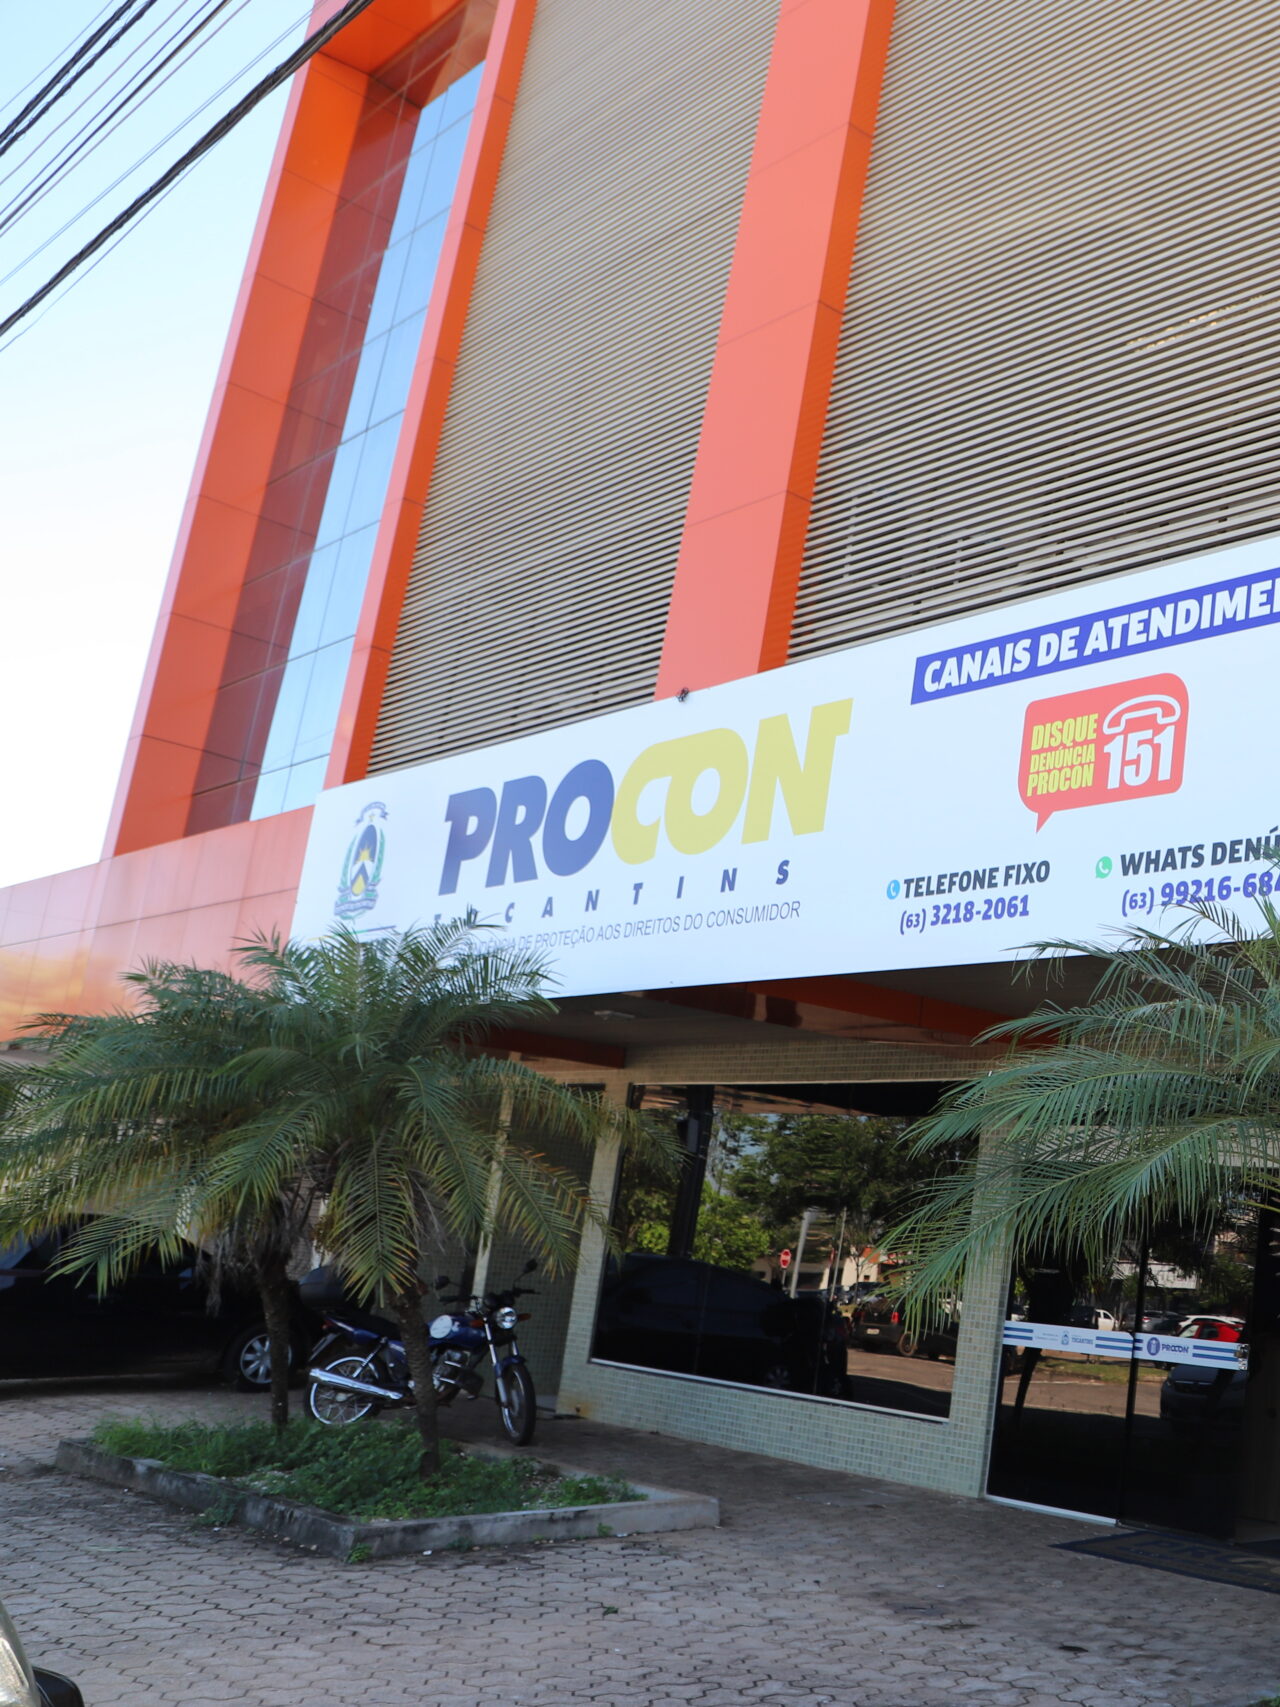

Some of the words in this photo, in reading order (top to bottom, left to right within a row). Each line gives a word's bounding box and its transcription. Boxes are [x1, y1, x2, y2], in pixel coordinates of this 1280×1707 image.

[923, 638, 1031, 692] CANAIS
[1036, 626, 1080, 667] DE
[1031, 713, 1099, 750] DISQUE
[1029, 743, 1096, 773] DENÚNCIA
[1103, 725, 1175, 789] 151
[438, 697, 853, 896] PROCON
[1026, 763, 1095, 797] PROCON
[904, 867, 999, 898] TELEFONE
[1003, 860, 1050, 887] FIXO
[1120, 844, 1205, 876] WHATS
[434, 860, 790, 927] CANTINS
[1122, 886, 1154, 917] (63)
[518, 936, 533, 951] DE
[535, 925, 595, 950] PROTEÇÃO
[597, 923, 621, 941] AOS
[623, 916, 681, 938] DIREITOS
[683, 913, 703, 931] DO
[706, 901, 801, 928] CONSUMIDOR
[900, 908, 926, 935] (63)
[931, 895, 1029, 926] 3218-2061
[1161, 1343, 1189, 1353] PROCON
